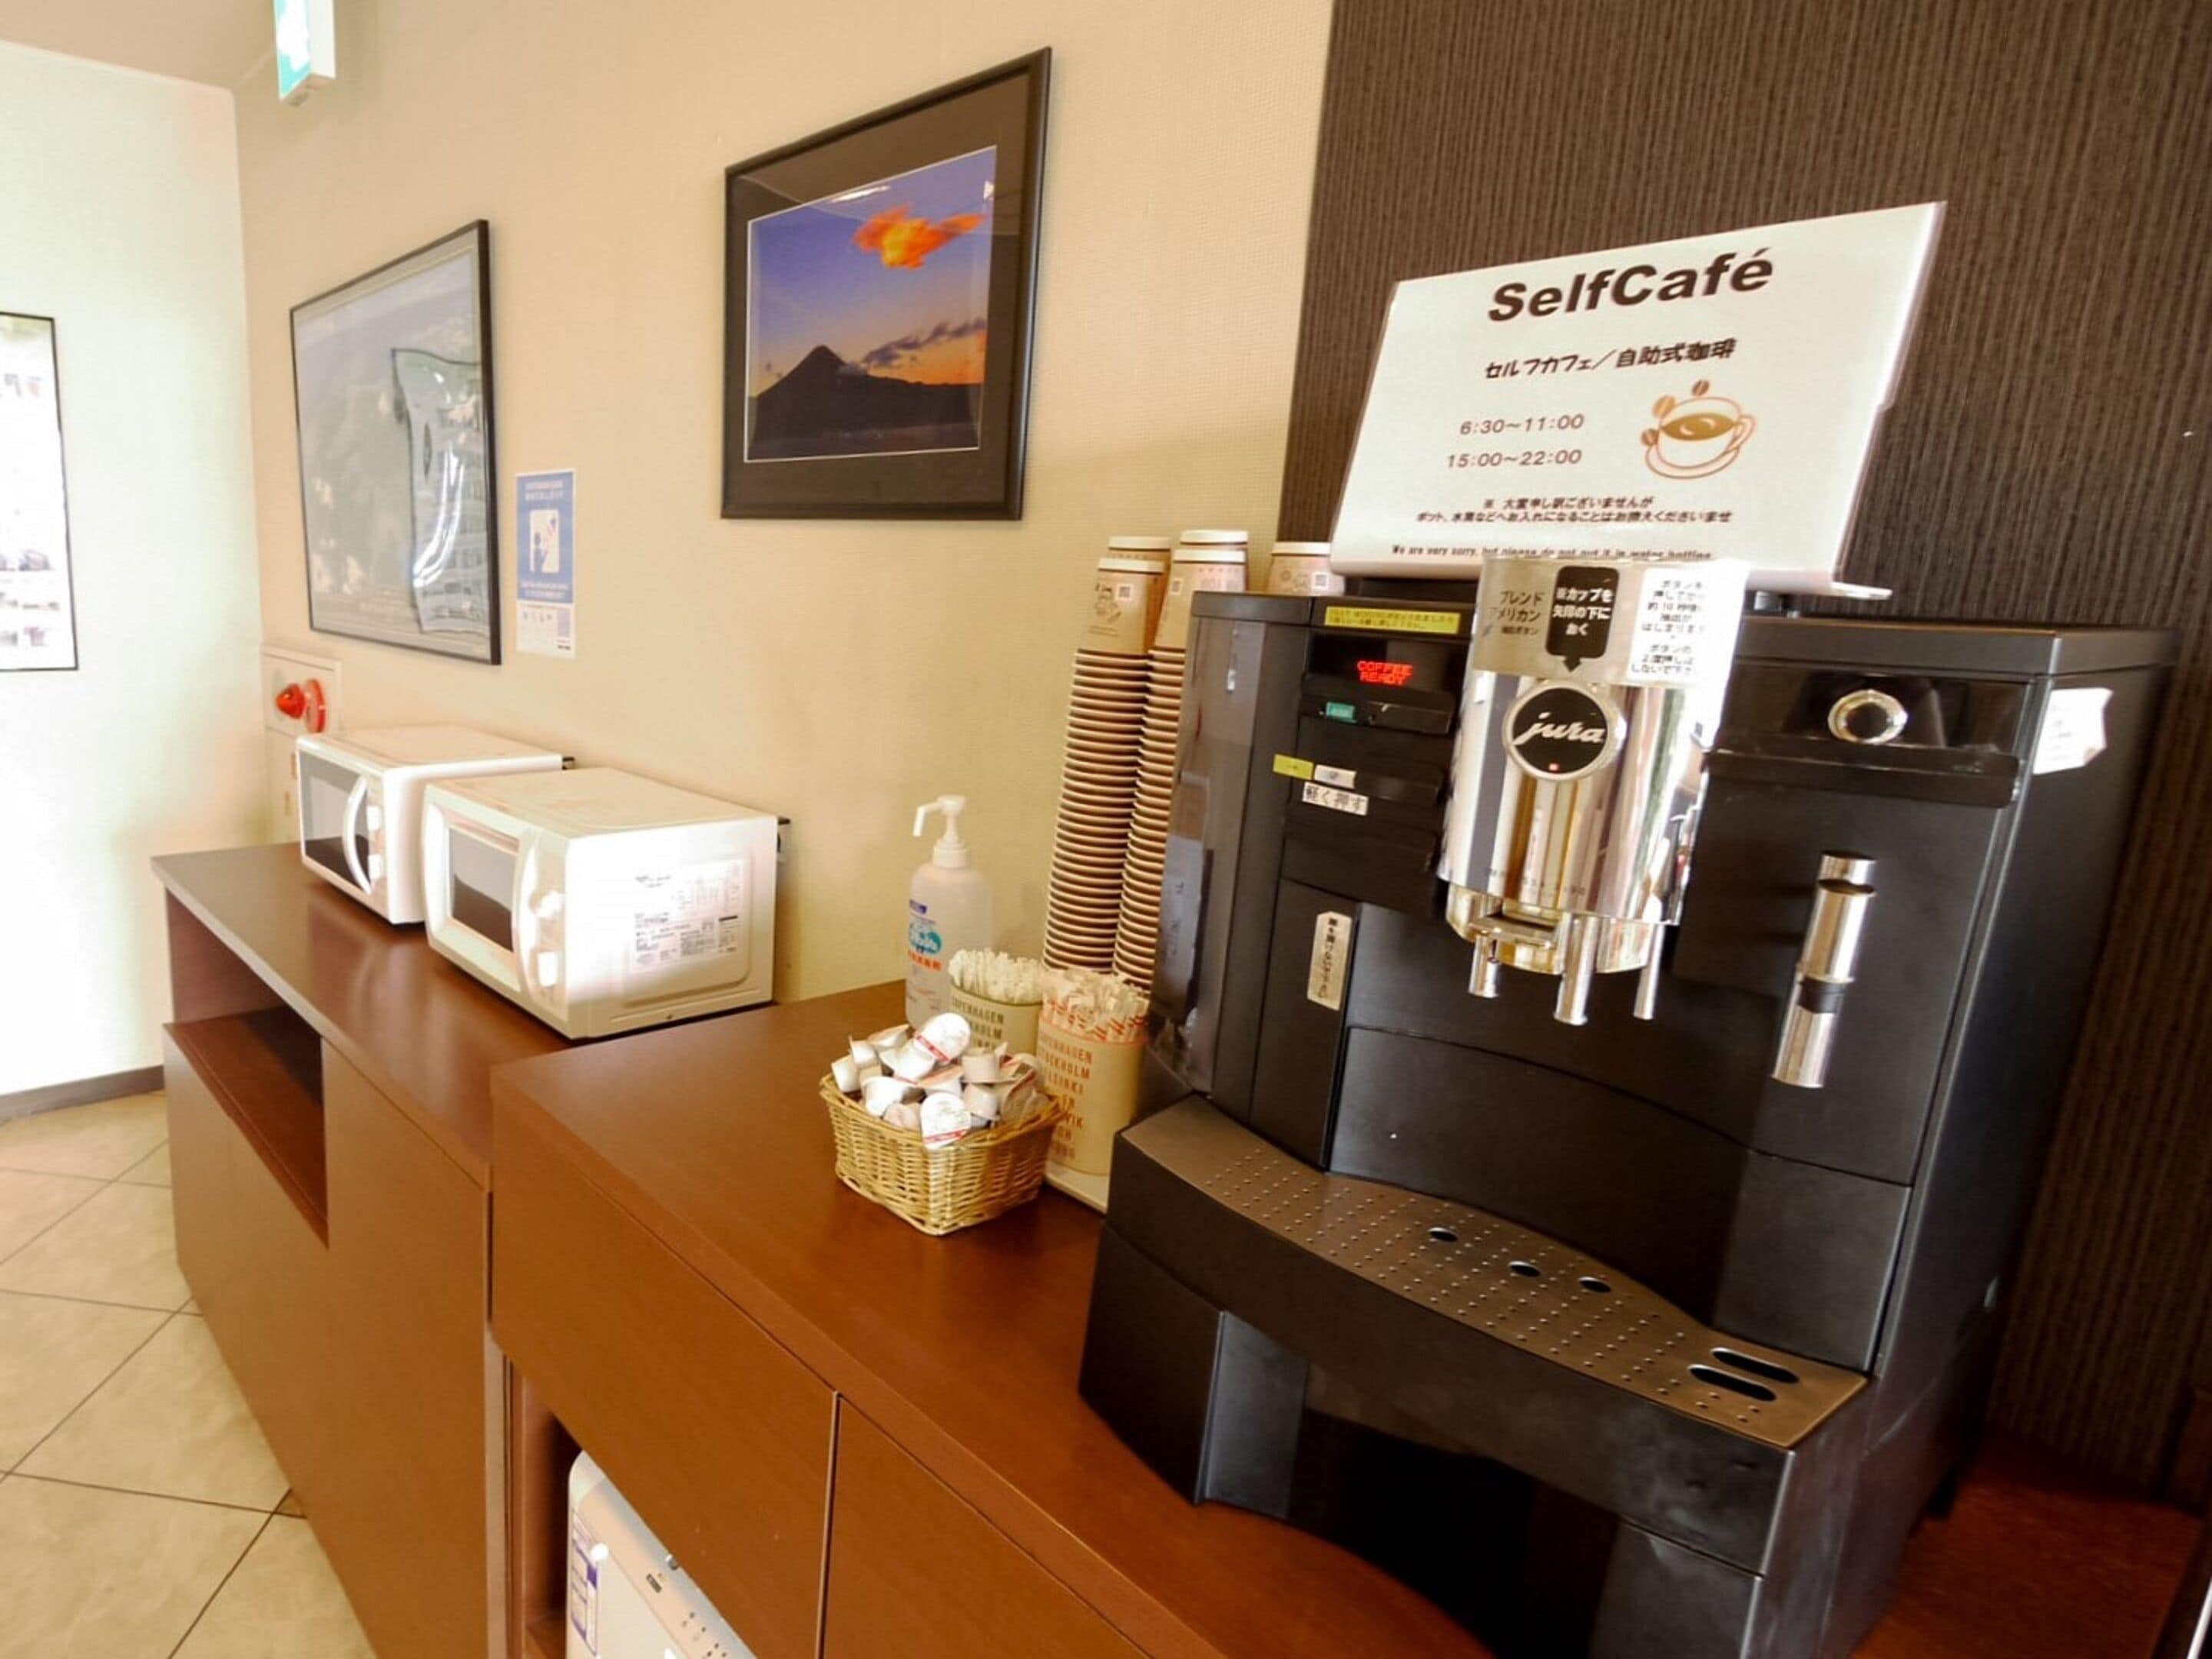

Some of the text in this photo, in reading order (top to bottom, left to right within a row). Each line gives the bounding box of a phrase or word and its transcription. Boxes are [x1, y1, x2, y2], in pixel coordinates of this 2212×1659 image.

[1488, 247, 1773, 322] SelfCafé
[1427, 547, 1449, 556] very
[1565, 622, 1589, 637] おく
[1356, 660, 1414, 676] COFFEE
[1359, 671, 1409, 687] READY
[1512, 711, 1606, 747] jura
